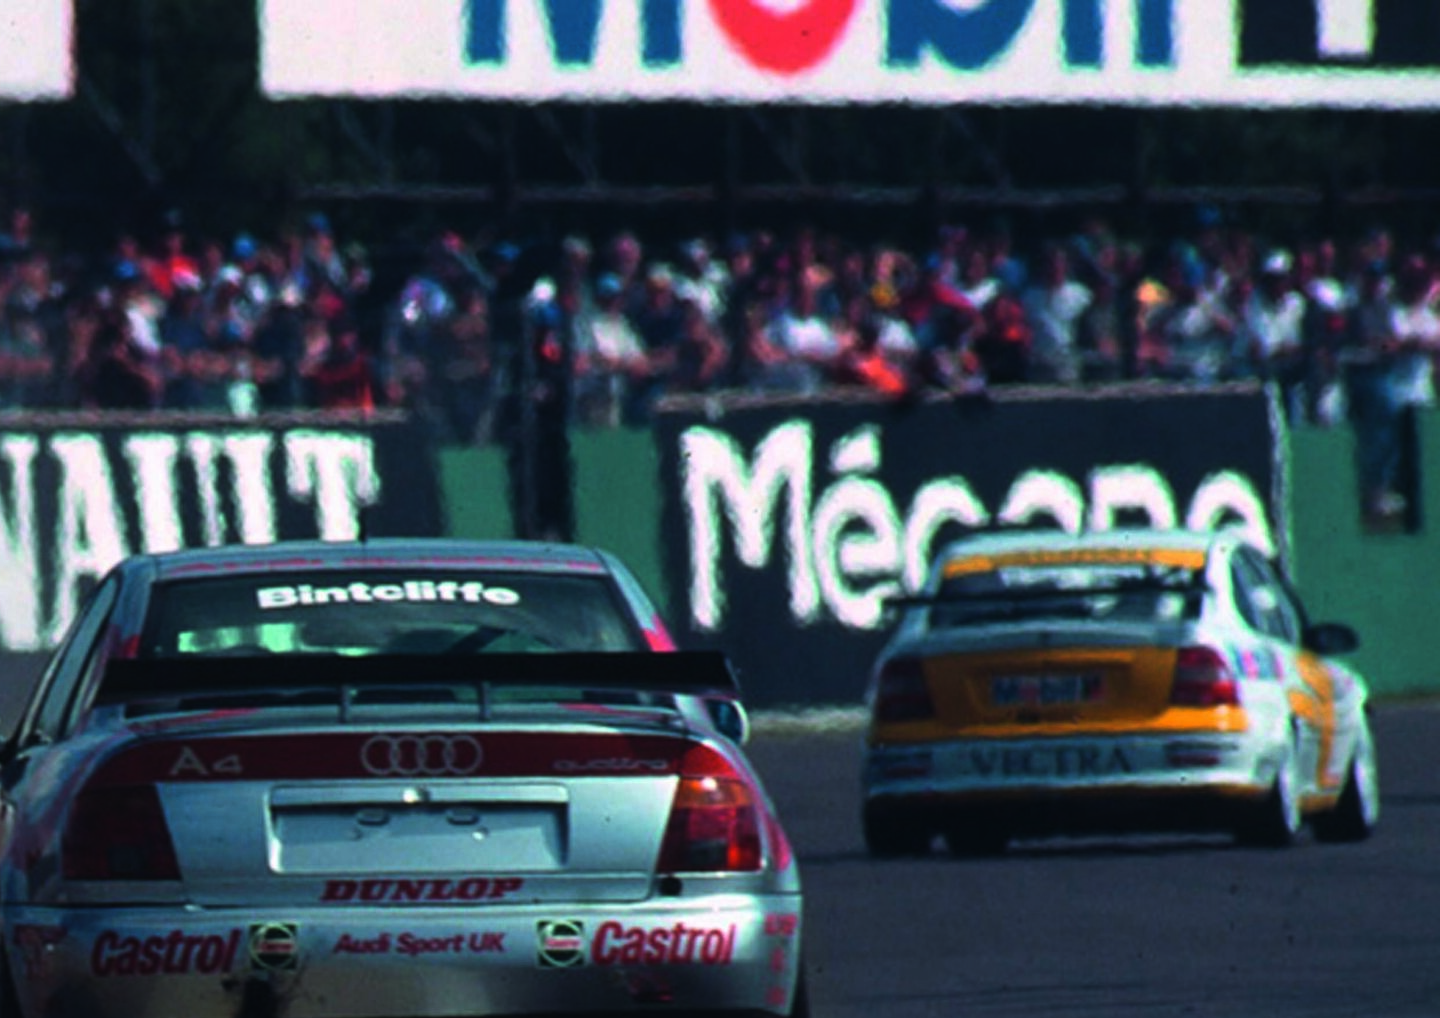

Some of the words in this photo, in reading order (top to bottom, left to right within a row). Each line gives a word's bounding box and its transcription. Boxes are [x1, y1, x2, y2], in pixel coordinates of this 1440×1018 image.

[169, 746, 244, 776] A4
[321, 877, 525, 903] DUNLOP
[90, 928, 243, 977] Castrol
[334, 932, 392, 954] Audi
[395, 932, 463, 956] Sport
[468, 932, 506, 953] UK
[591, 920, 736, 965] Castrol
